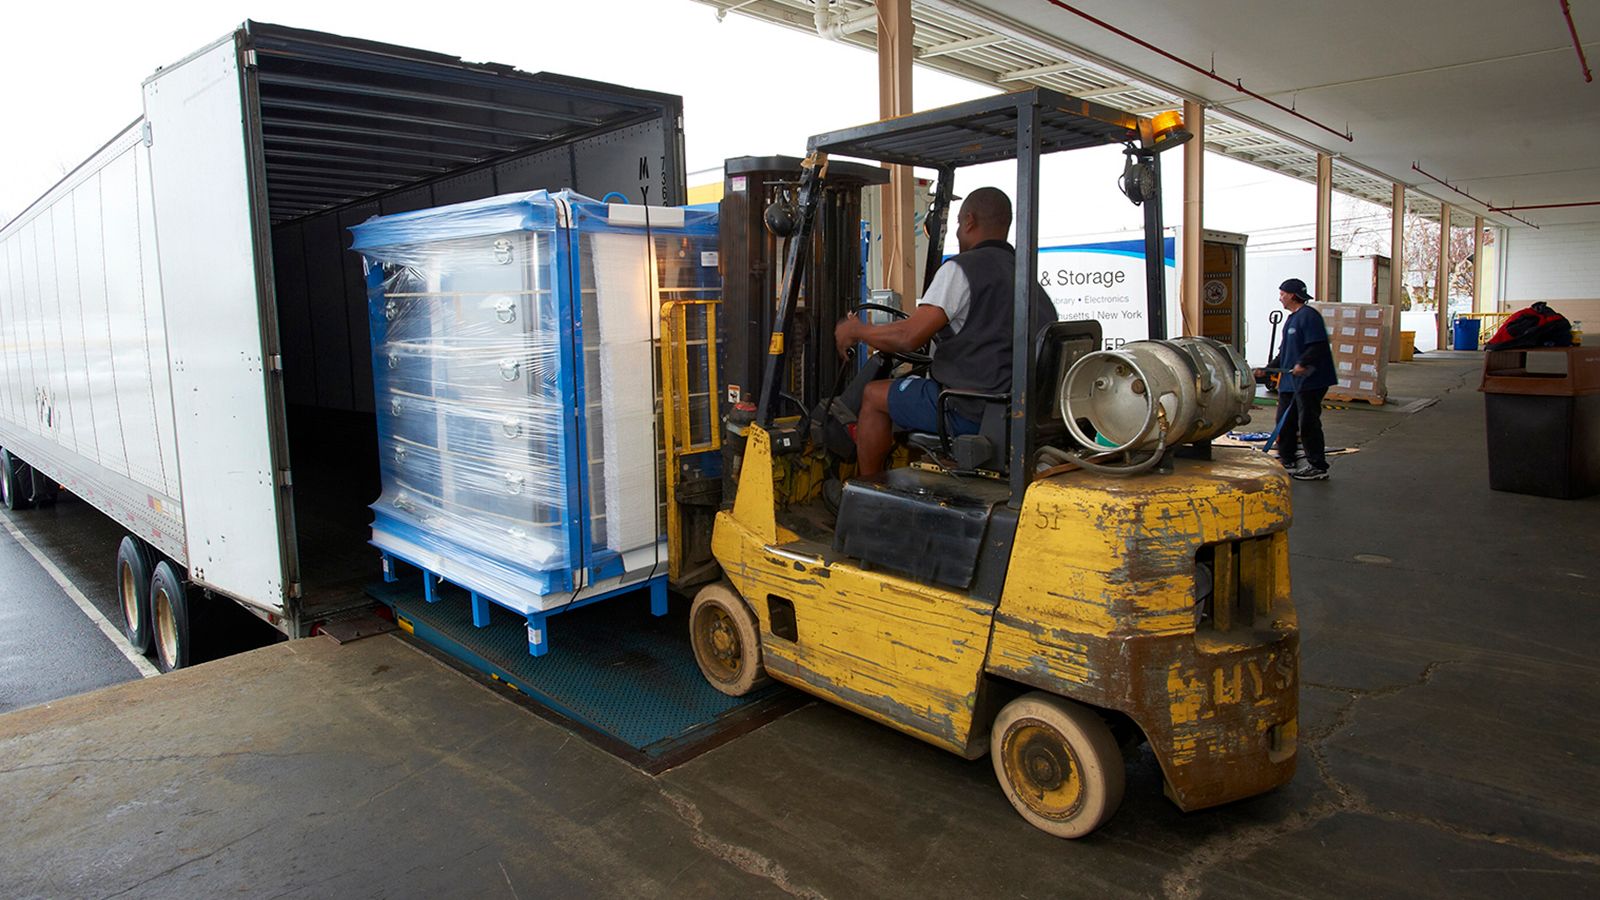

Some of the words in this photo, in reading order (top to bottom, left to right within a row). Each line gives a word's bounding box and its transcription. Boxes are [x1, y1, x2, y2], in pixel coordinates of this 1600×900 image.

[1040, 270, 1052, 287] &
[1057, 269, 1125, 288] Storage
[1084, 295, 1129, 304] Electronics
[1057, 312, 1090, 320] husetts
[1097, 311, 1118, 320] New
[1121, 310, 1142, 319] York
